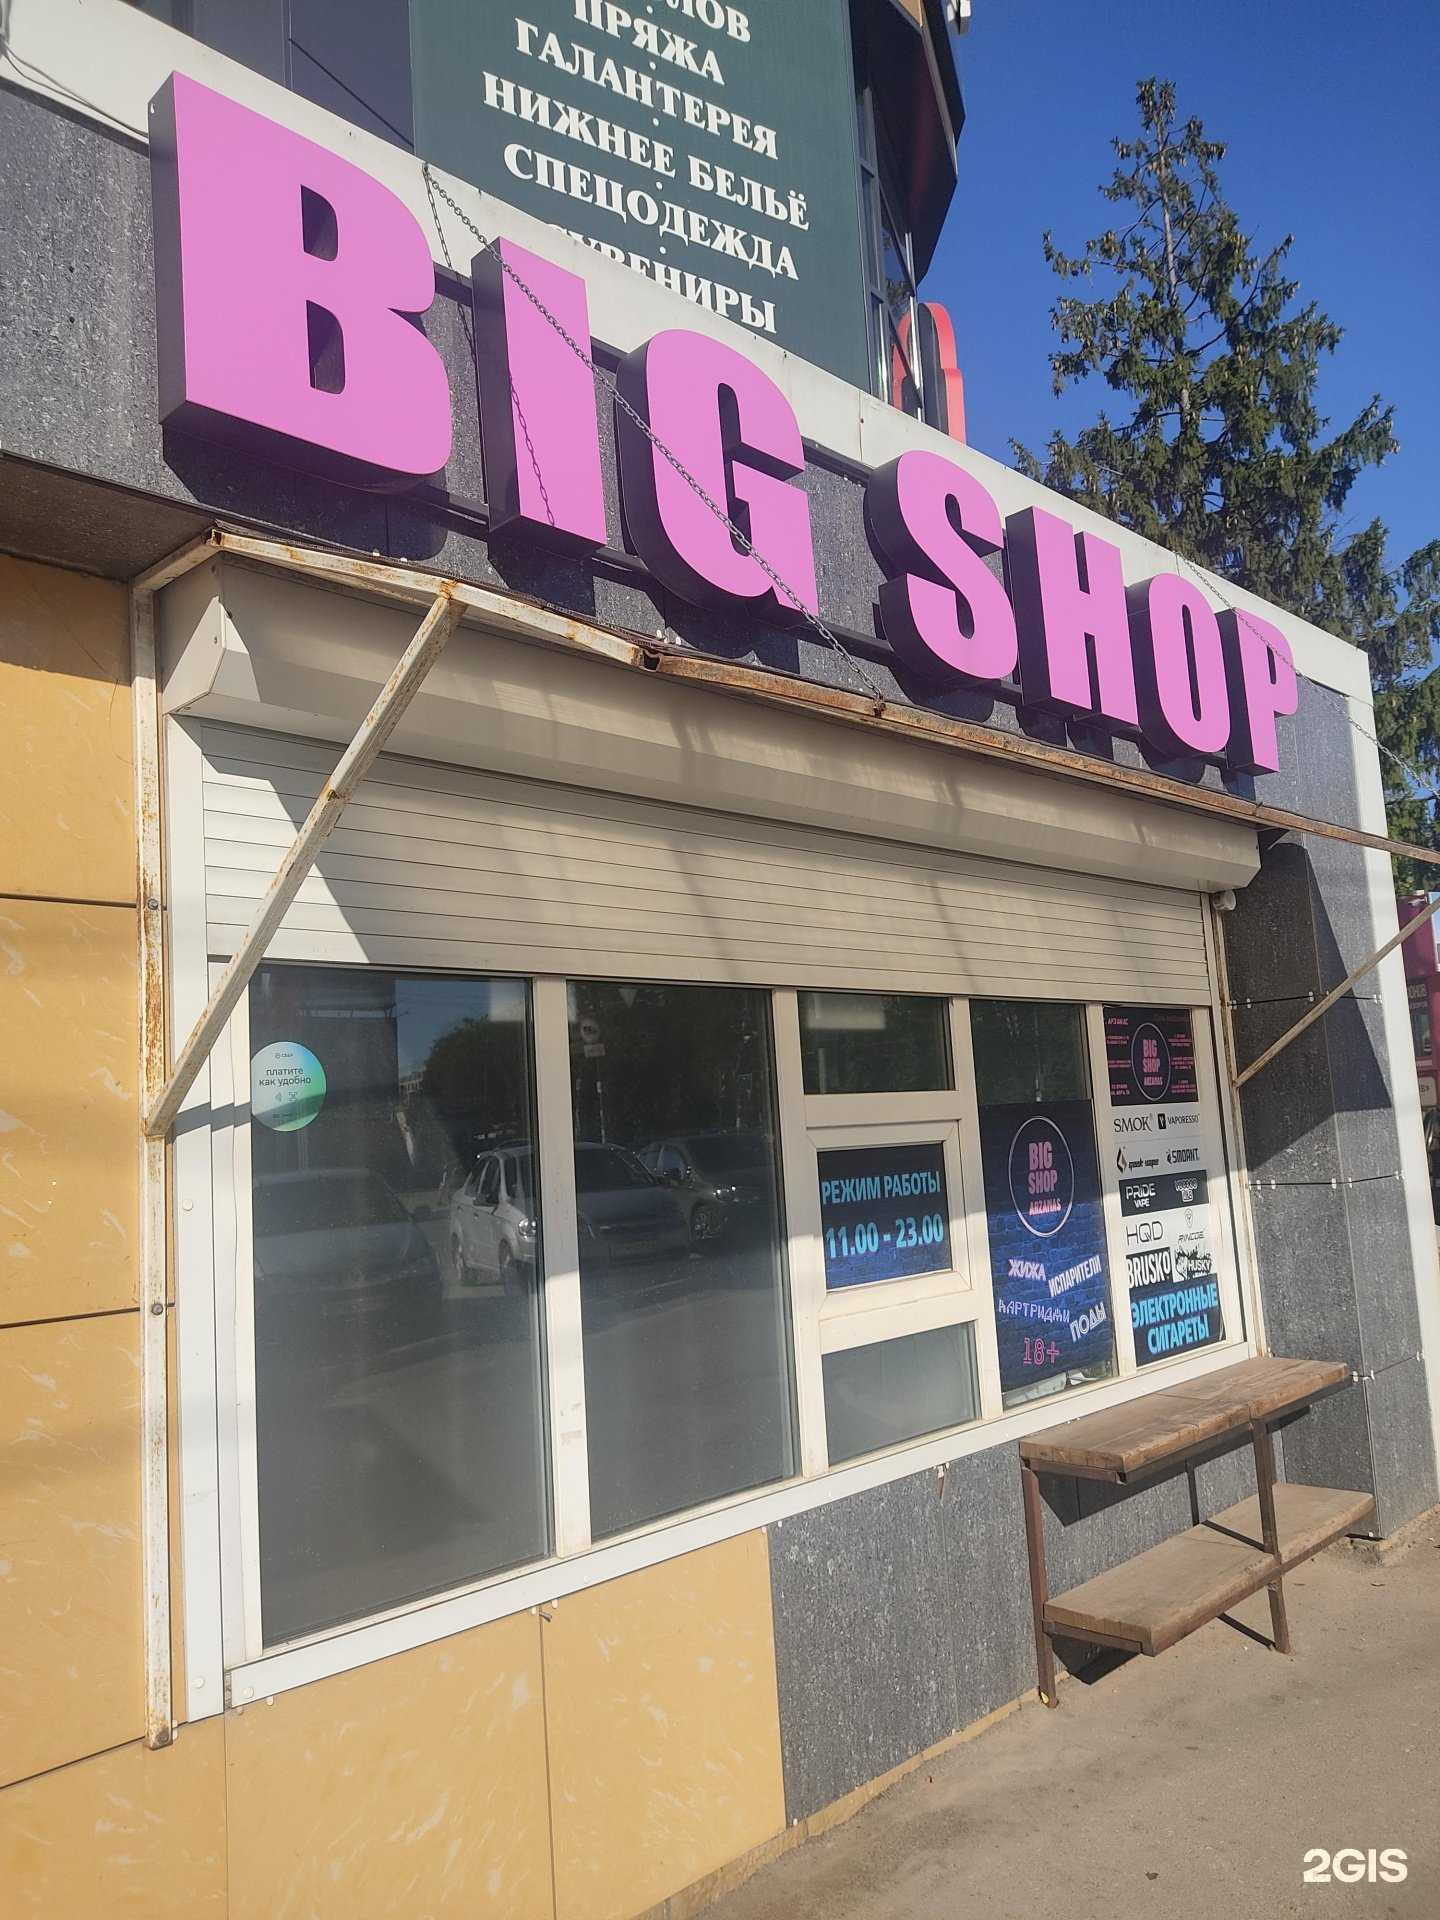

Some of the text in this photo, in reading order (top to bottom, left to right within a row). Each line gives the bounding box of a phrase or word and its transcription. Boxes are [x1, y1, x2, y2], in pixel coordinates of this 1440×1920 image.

[574, 0, 726, 86] ПРЯЖА
[515, 18, 778, 160] ГАЛАНТЕРЕЯ
[482, 72, 810, 230] НИЖНЕЕ БЕЛЬЁ
[503, 143, 799, 281] СПЕЦОДЕЖДА
[549, 224, 777, 334] ЕНИРЫ
[150, 70, 1298, 773] BIG SHOP
[1142, 1039, 1157, 1057] BIG
[1142, 1057, 1160, 1072] SHOP
[266, 1067, 304, 1077] платите
[278, 1076, 312, 1087] удобно
[1113, 1116, 1152, 1132] SMOK
[1167, 1114, 1200, 1125] VAPORESSO
[1028, 1141, 1053, 1170] BIG
[821, 1171, 941, 1205] РЕЖИМ РАБОТЫ
[1028, 1170, 1058, 1194] SHOP
[826, 1222, 879, 1259] 11.00
[895, 1213, 944, 1248] 23.00
[1125, 1221, 1163, 1246] HQD
[1008, 1259, 1046, 1281] ЖИЖА
[1048, 1255, 1102, 1298] ИСПАРИТЕЛИ
[1127, 1250, 1171, 1288] BRUSKO
[999, 1299, 1070, 1323] КАРТРИДЖИ
[1069, 1301, 1107, 1343] ПОДЫ
[1130, 1282, 1218, 1329] ЭЛЕКТРОННЫЕ
[1147, 1313, 1209, 1355] СИГАРЕТЫ
[1023, 1337, 1060, 1366] 18+
